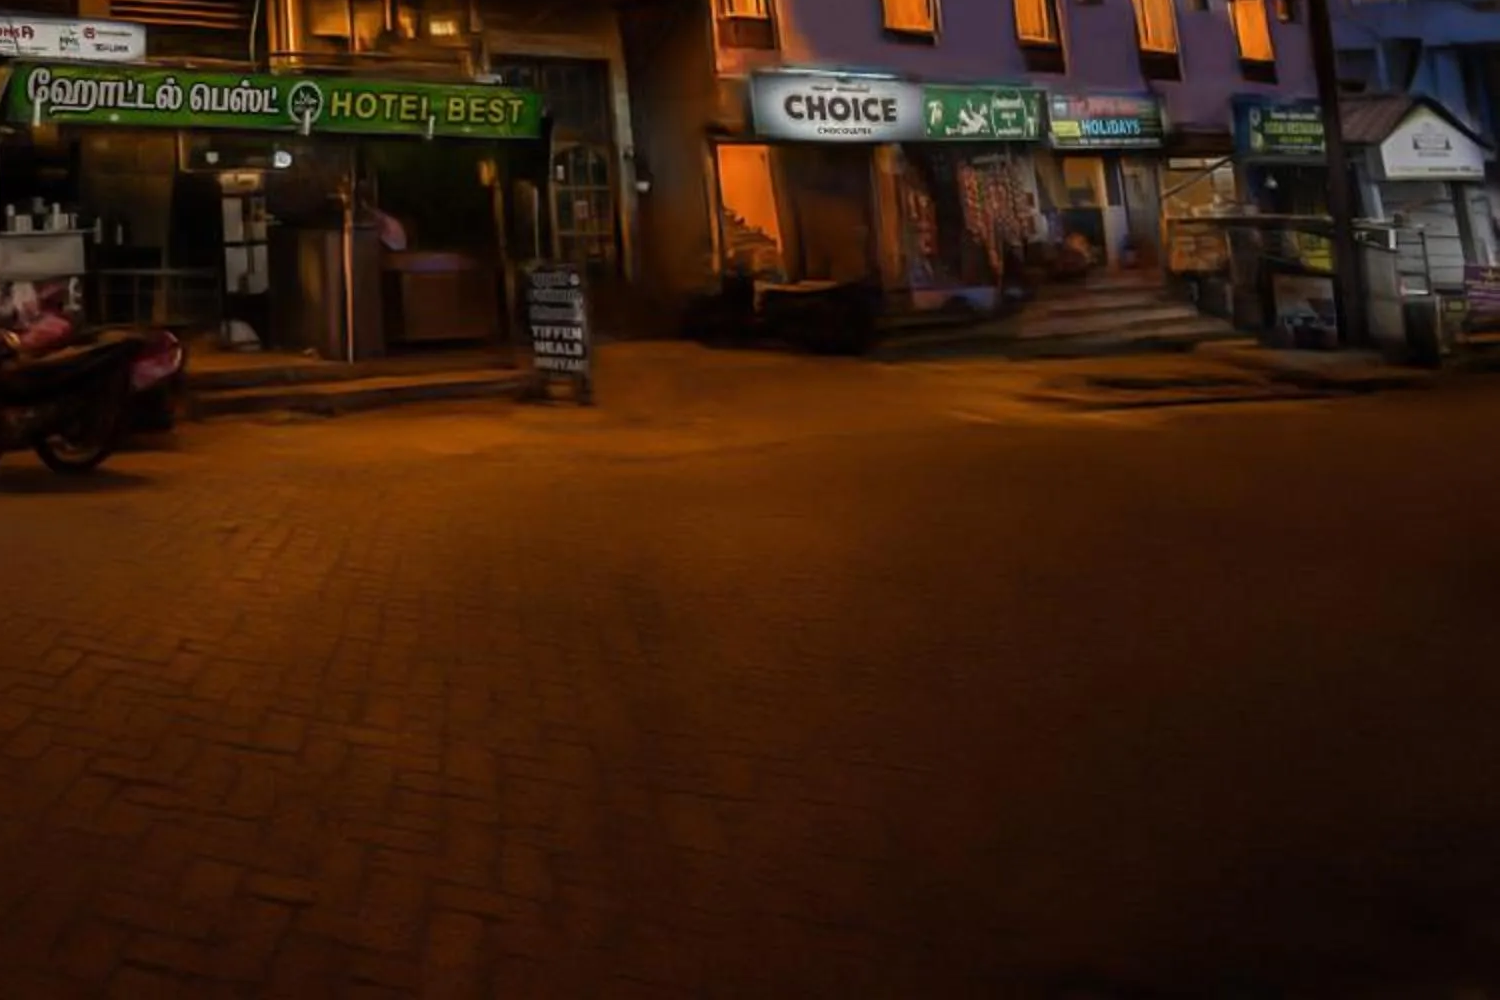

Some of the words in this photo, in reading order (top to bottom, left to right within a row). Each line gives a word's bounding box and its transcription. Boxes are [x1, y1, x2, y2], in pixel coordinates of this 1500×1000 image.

[330, 89, 432, 121] HOTEL
[446, 95, 524, 124] BEST
[783, 94, 898, 122] CHOICE
[1081, 119, 1141, 135] HOLIDAYS
